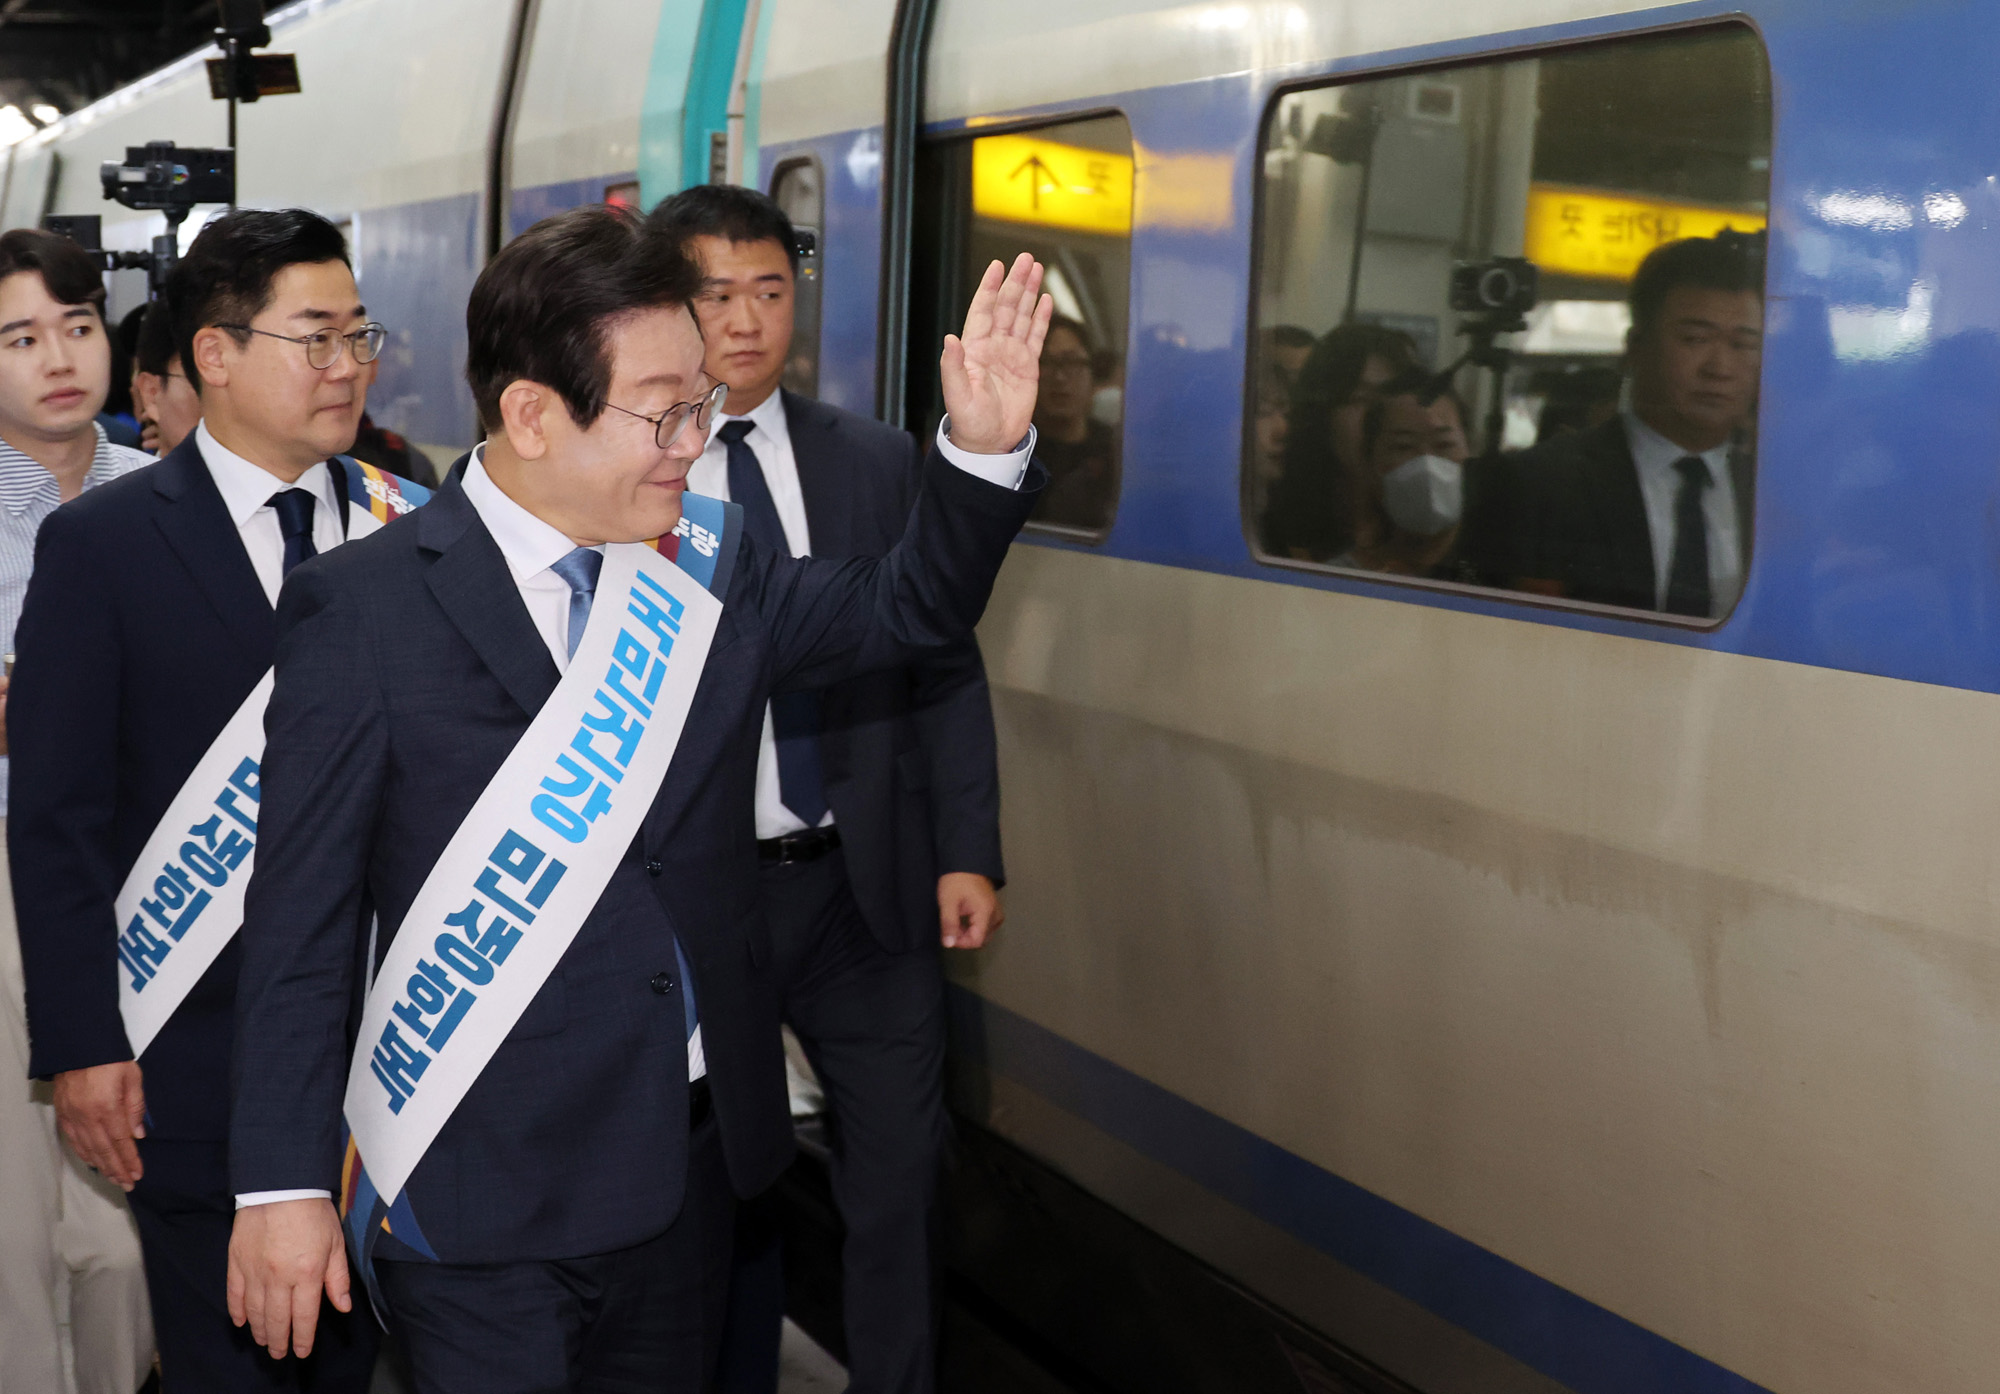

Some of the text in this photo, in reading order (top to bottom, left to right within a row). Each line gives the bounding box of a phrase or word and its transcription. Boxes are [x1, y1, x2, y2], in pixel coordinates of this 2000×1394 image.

[361, 476, 417, 515] 민주
[370, 570, 686, 1116] 국민건강 민생회복
